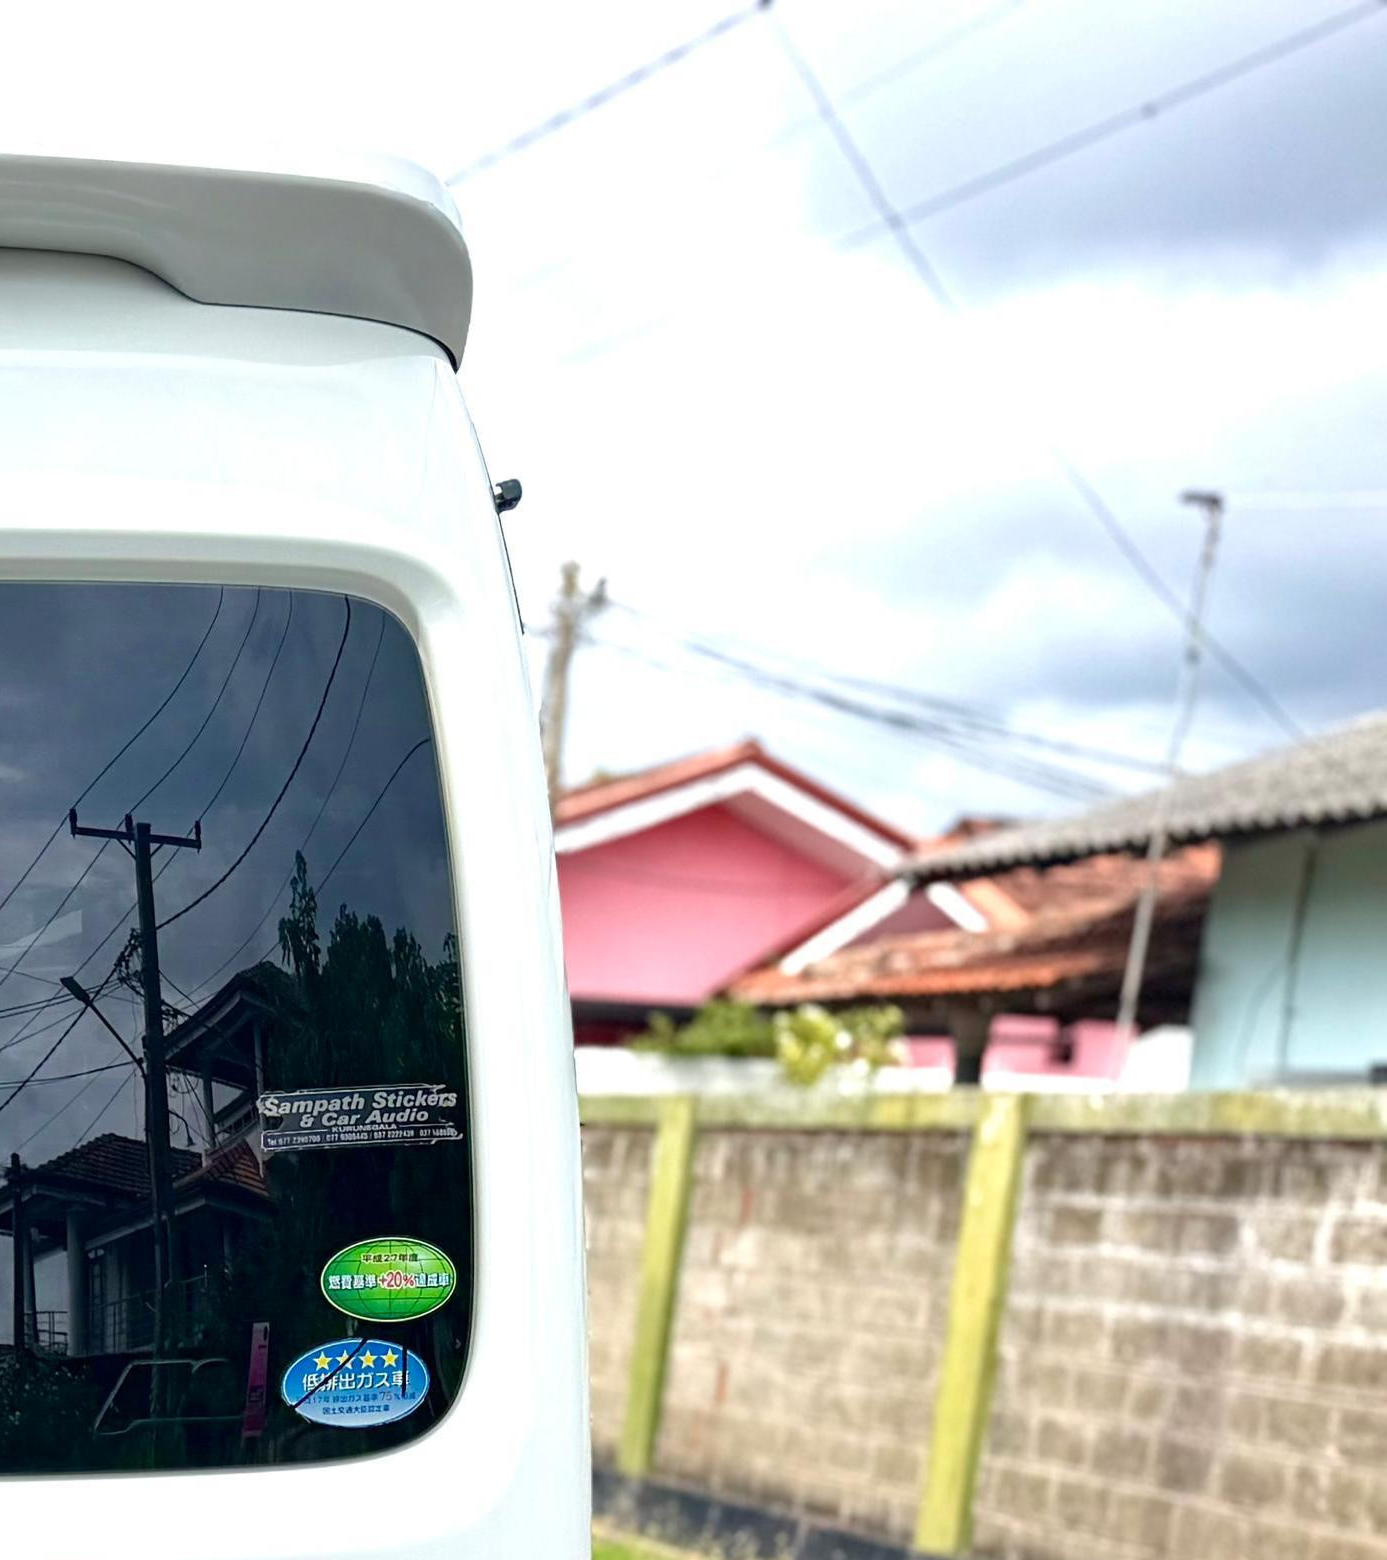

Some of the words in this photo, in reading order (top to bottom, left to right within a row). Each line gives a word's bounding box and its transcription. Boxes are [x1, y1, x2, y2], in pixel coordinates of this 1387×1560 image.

[264, 1097, 365, 1117] Sampath
[371, 1091, 458, 1109] Stickers
[299, 1114, 314, 1128] &
[321, 1112, 361, 1126] Car
[364, 1107, 429, 1124] Audio
